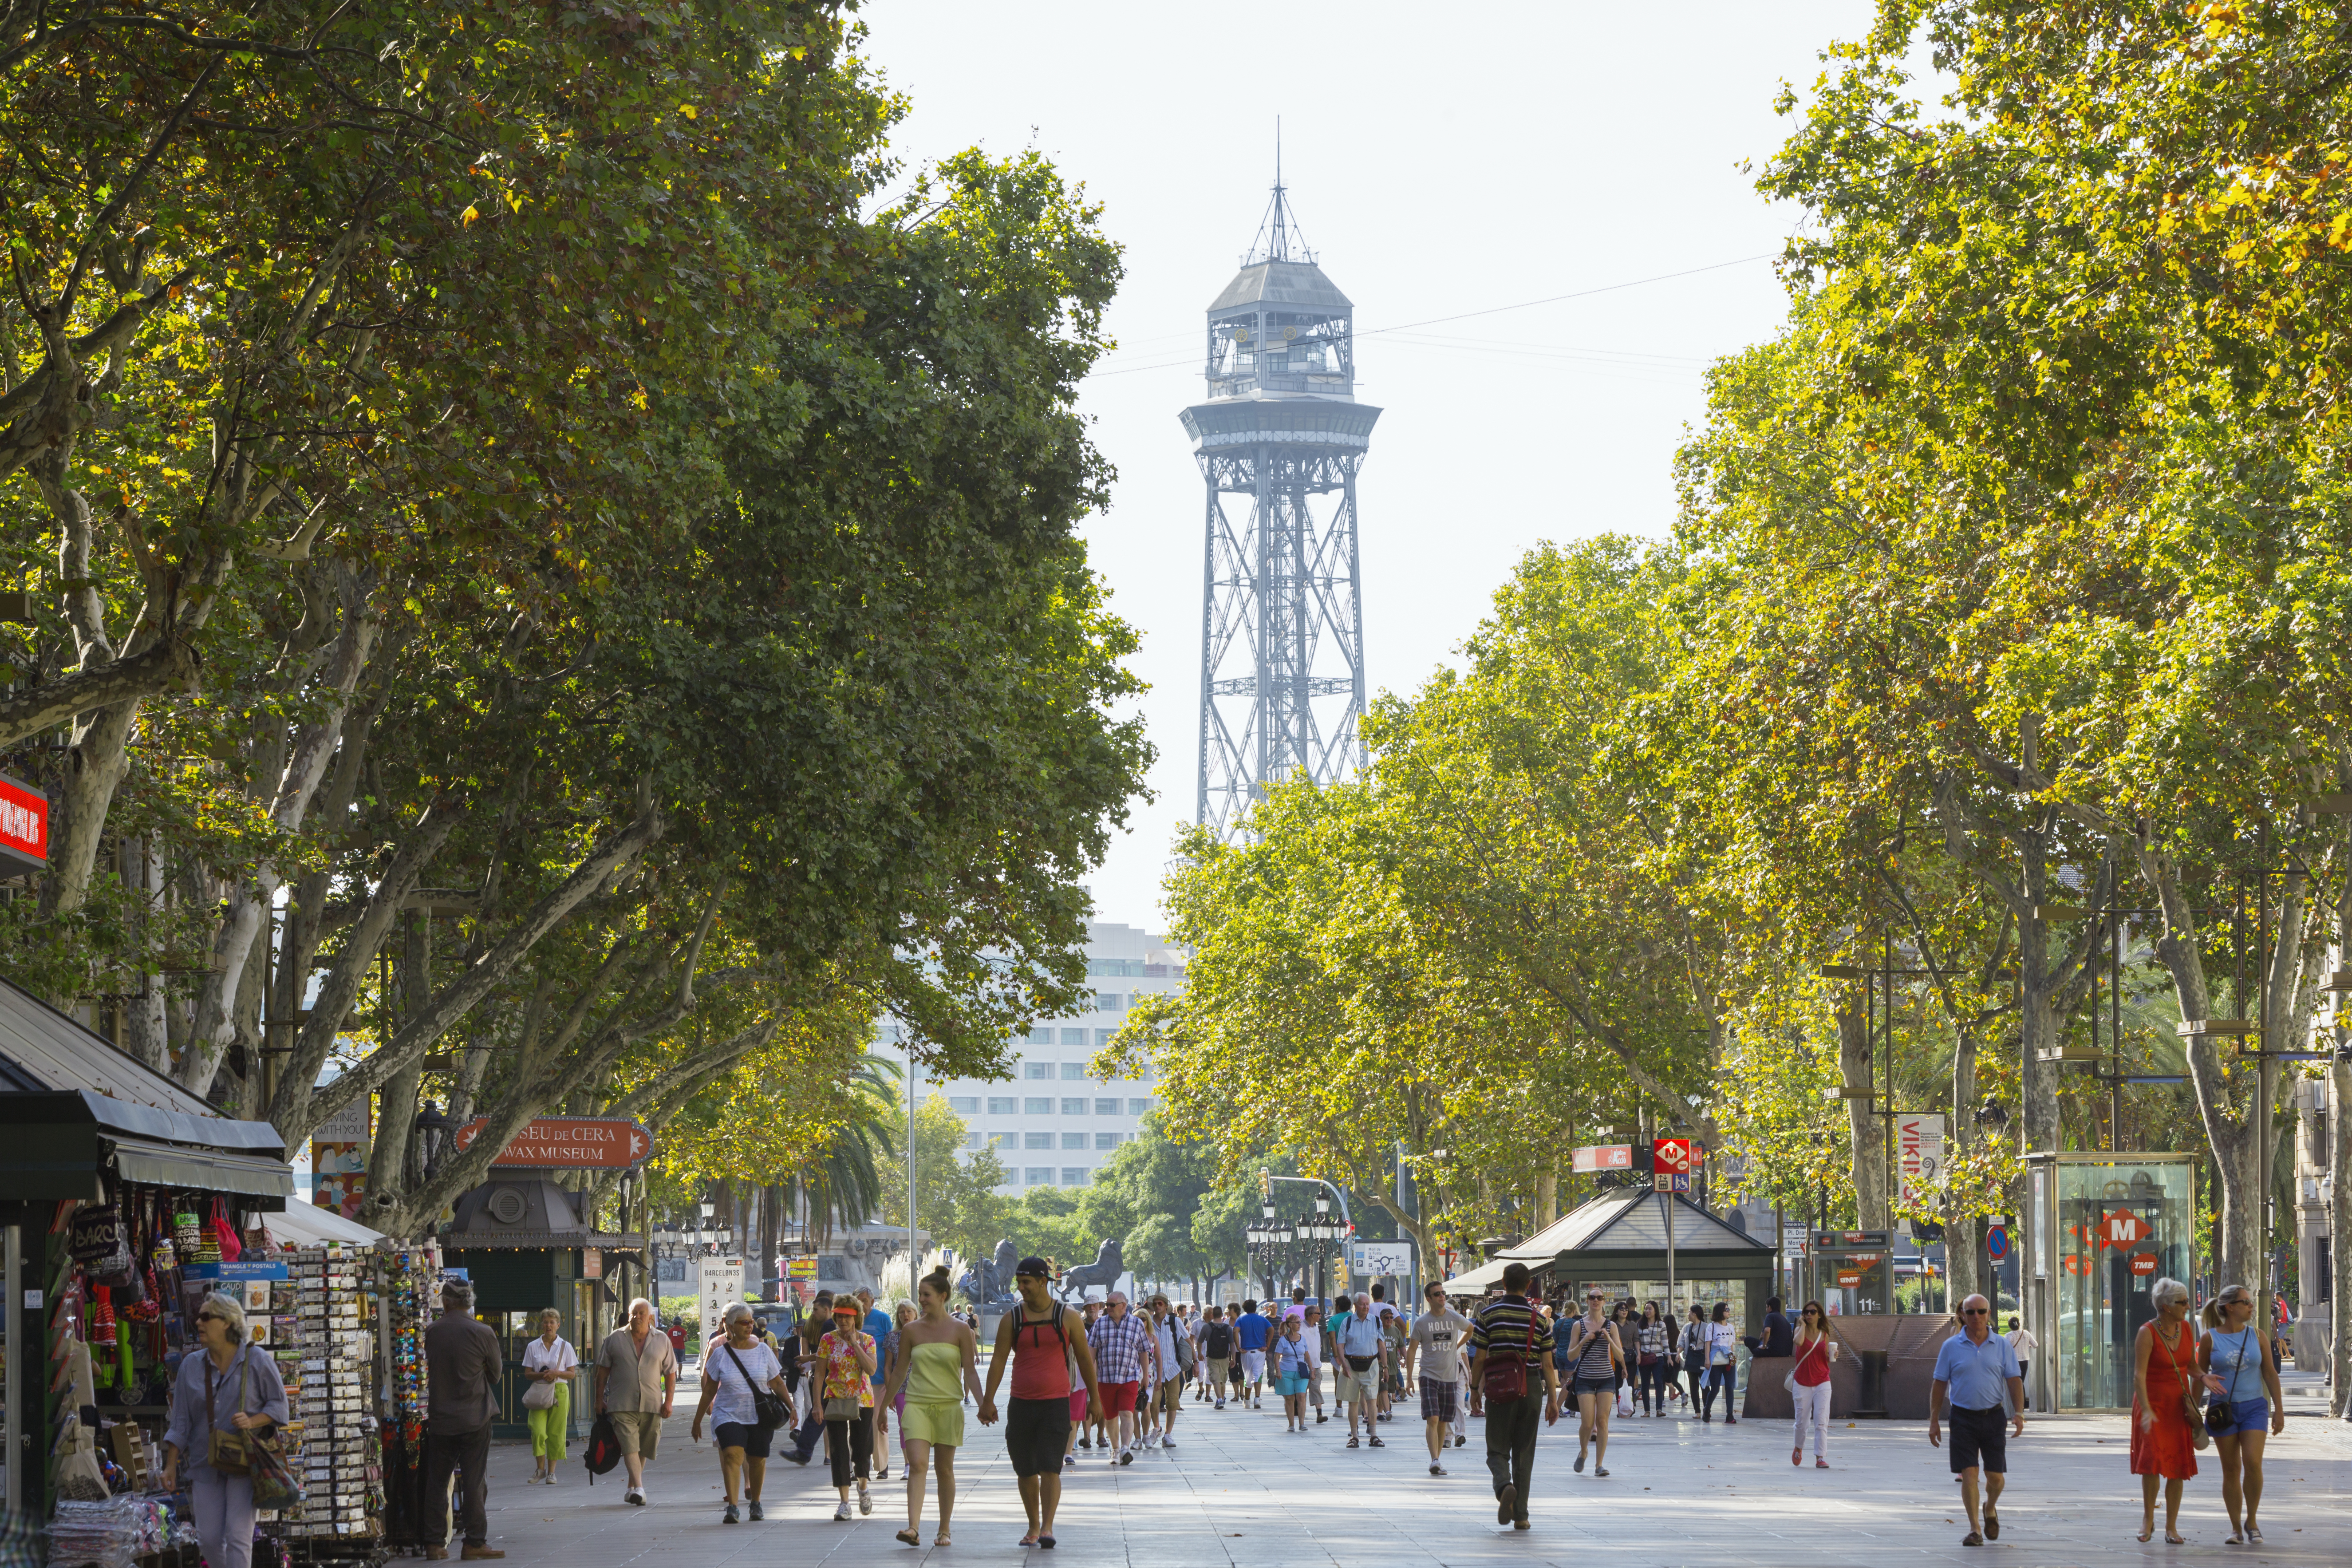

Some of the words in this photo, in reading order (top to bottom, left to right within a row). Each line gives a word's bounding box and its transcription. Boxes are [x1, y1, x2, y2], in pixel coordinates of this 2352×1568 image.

[318, 1125, 341, 1134] WITH
[343, 1125, 364, 1134] YOU!
[520, 1126, 551, 1140] SEU
[554, 1131, 569, 1141] DE
[572, 1127, 616, 1141] CERA
[505, 1146, 536, 1158] WAX
[540, 1147, 604, 1160] MUSEUM
[1665, 1148, 1677, 1158] M
[2111, 1219, 2135, 1240] M
[1837, 1264, 1867, 1274] insaciables
[728, 1282, 733, 1292] 2
[712, 1317, 717, 1327] 5
[1428, 1321, 1454, 1331] HOLLI
